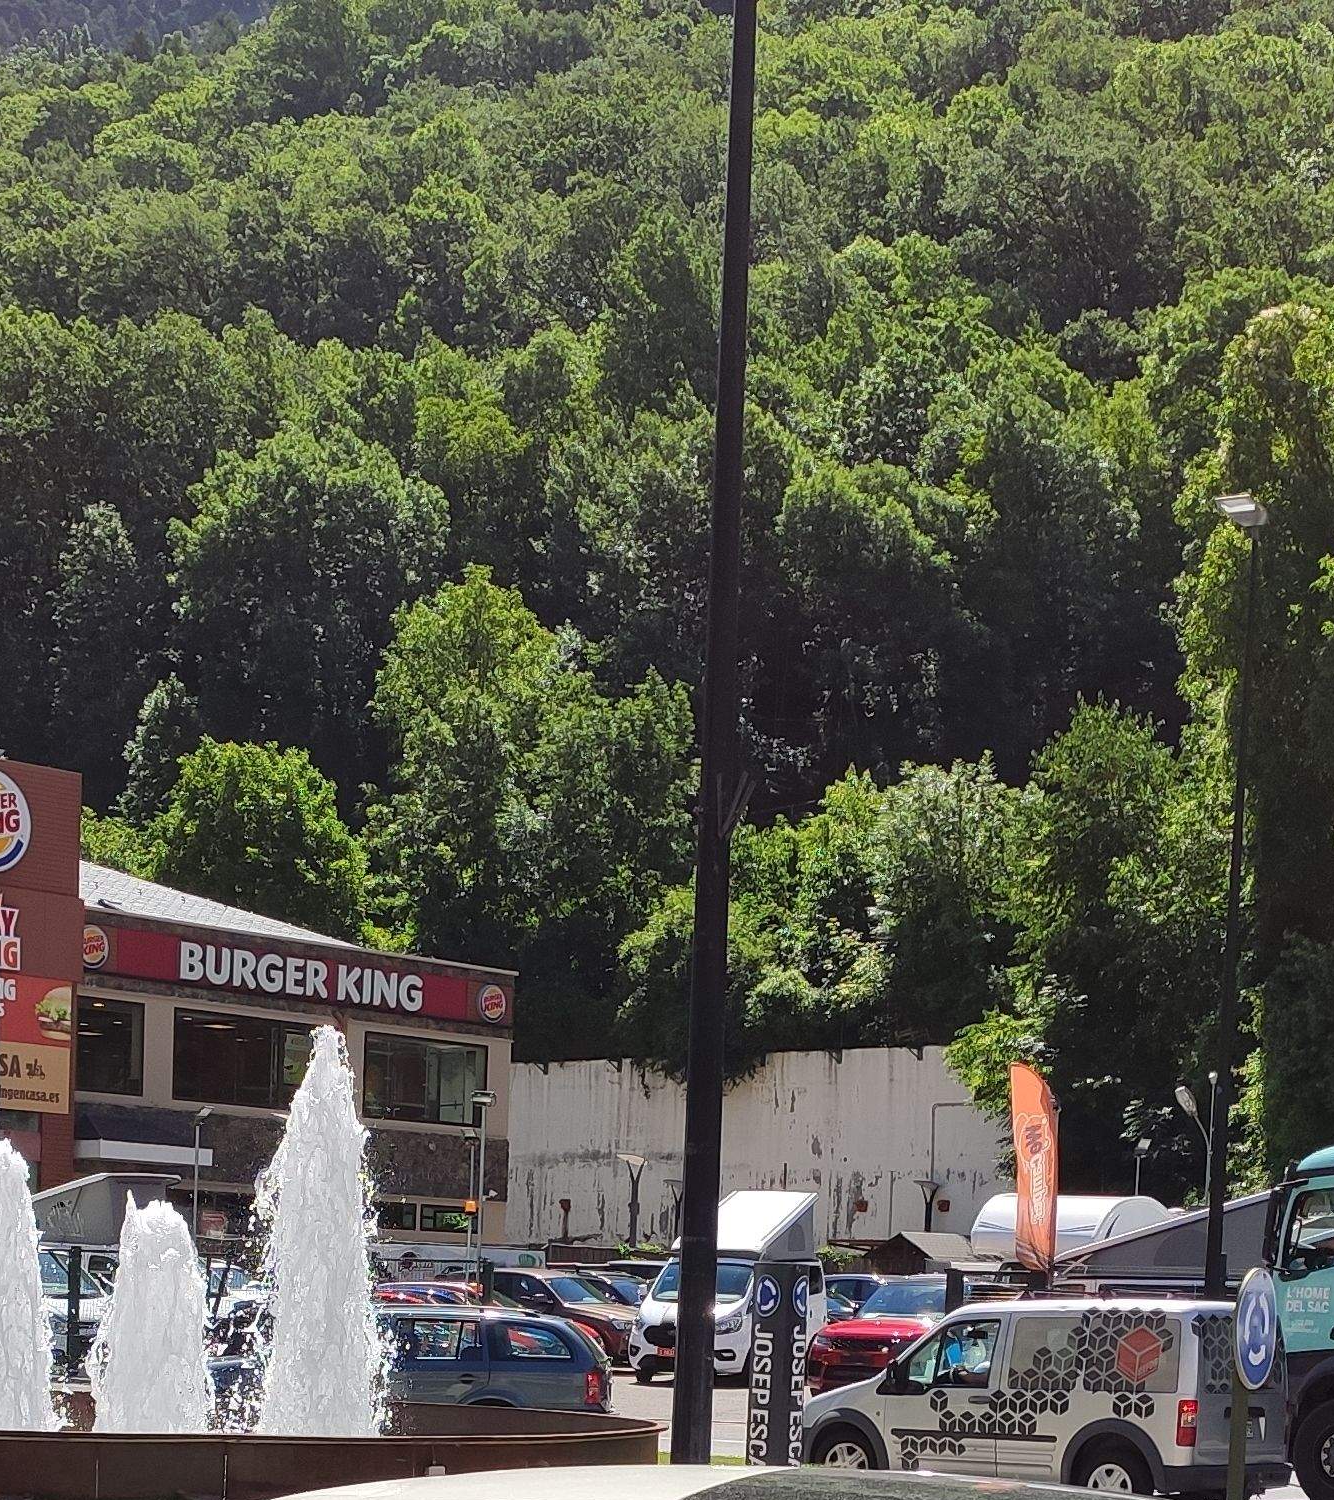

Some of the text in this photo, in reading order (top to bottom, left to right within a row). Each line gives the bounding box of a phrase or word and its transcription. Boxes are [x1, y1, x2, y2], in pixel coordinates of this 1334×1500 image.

[179, 940, 424, 1013] BURGER KING
[1285, 1300, 1330, 1314] DEL SAC
[748, 1323, 774, 1467] JOSEP ESCA
[787, 1411, 803, 1468] ESCA
